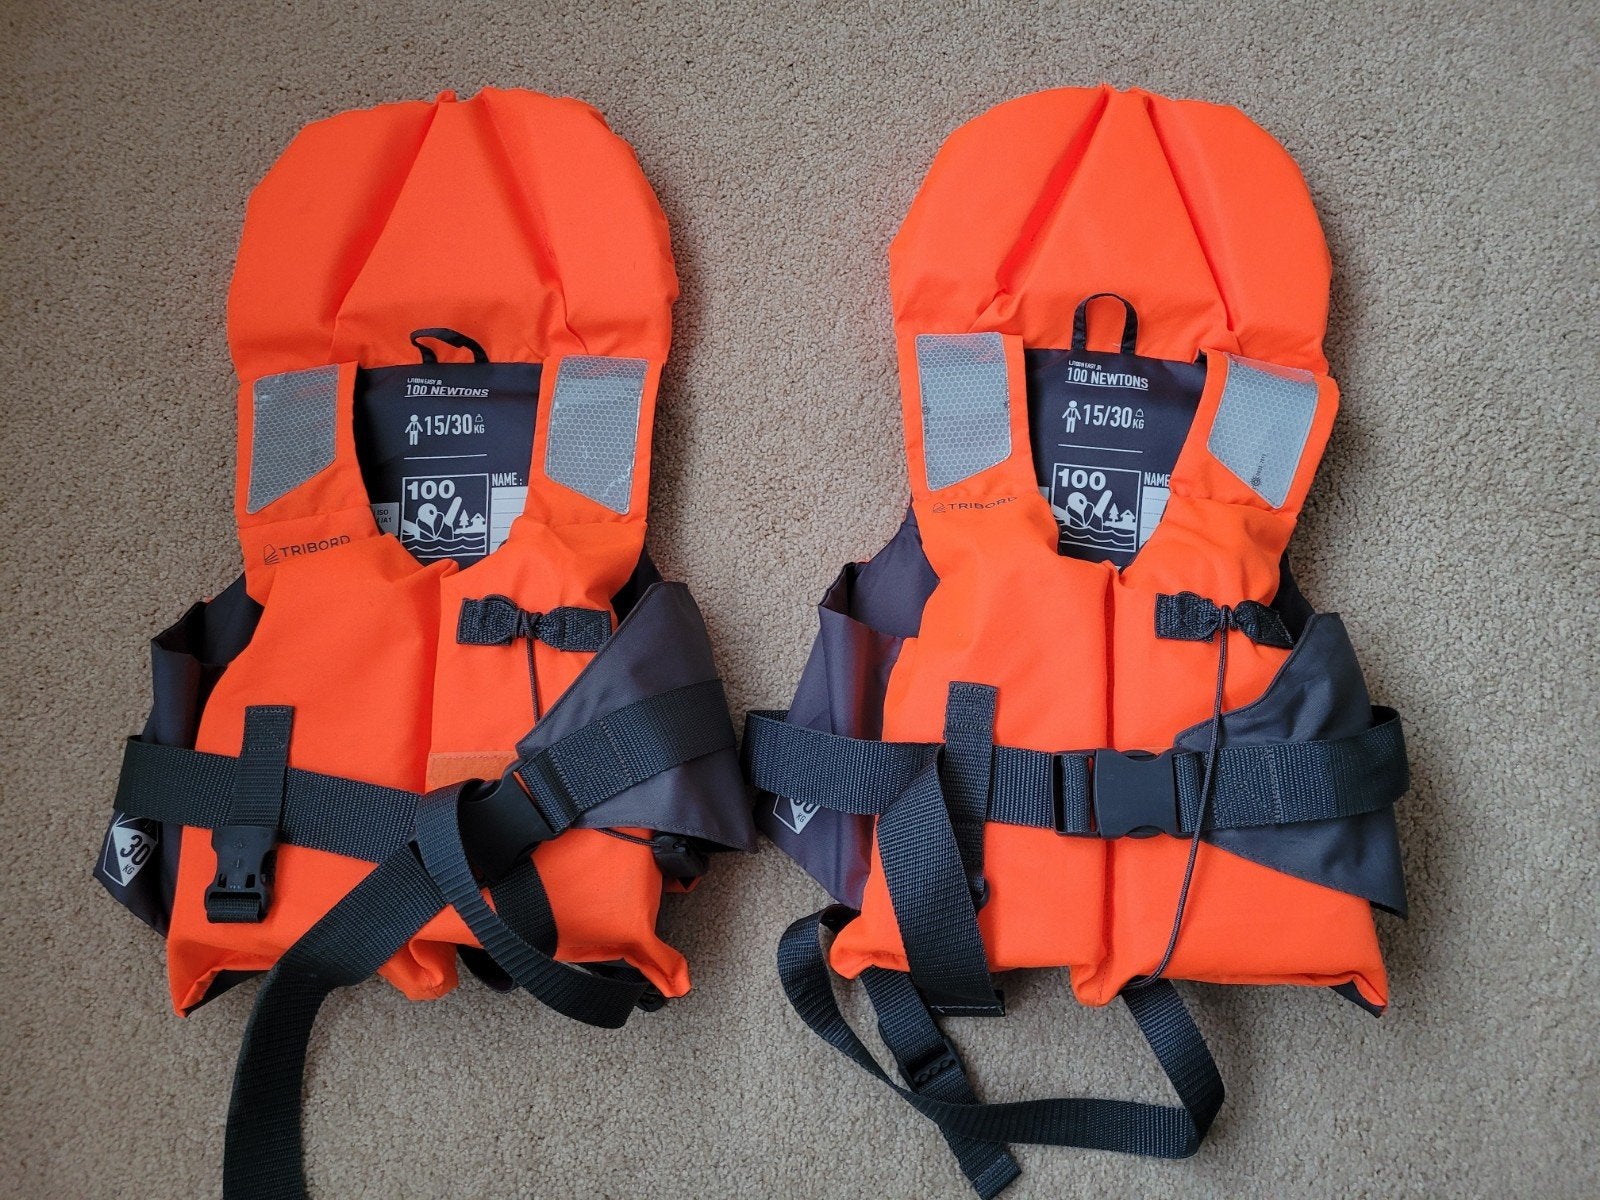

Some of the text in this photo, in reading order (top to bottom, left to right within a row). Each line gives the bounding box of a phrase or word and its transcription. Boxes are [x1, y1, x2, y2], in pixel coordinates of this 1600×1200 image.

[1067, 366, 1149, 389] 100 NEWTONS
[406, 384, 490, 397] 100 NEWTONS
[424, 413, 485, 436] 15/30 KG
[1083, 404, 1145, 430] 15/30 KG
[407, 479, 456, 501] 100
[1058, 468, 1107, 491] 100
[1144, 471, 1170, 487] NAME
[280, 535, 351, 558] TRIBORD
[796, 812, 807, 823] KG
[120, 834, 151, 866] 30
[122, 864, 135, 875] KG
